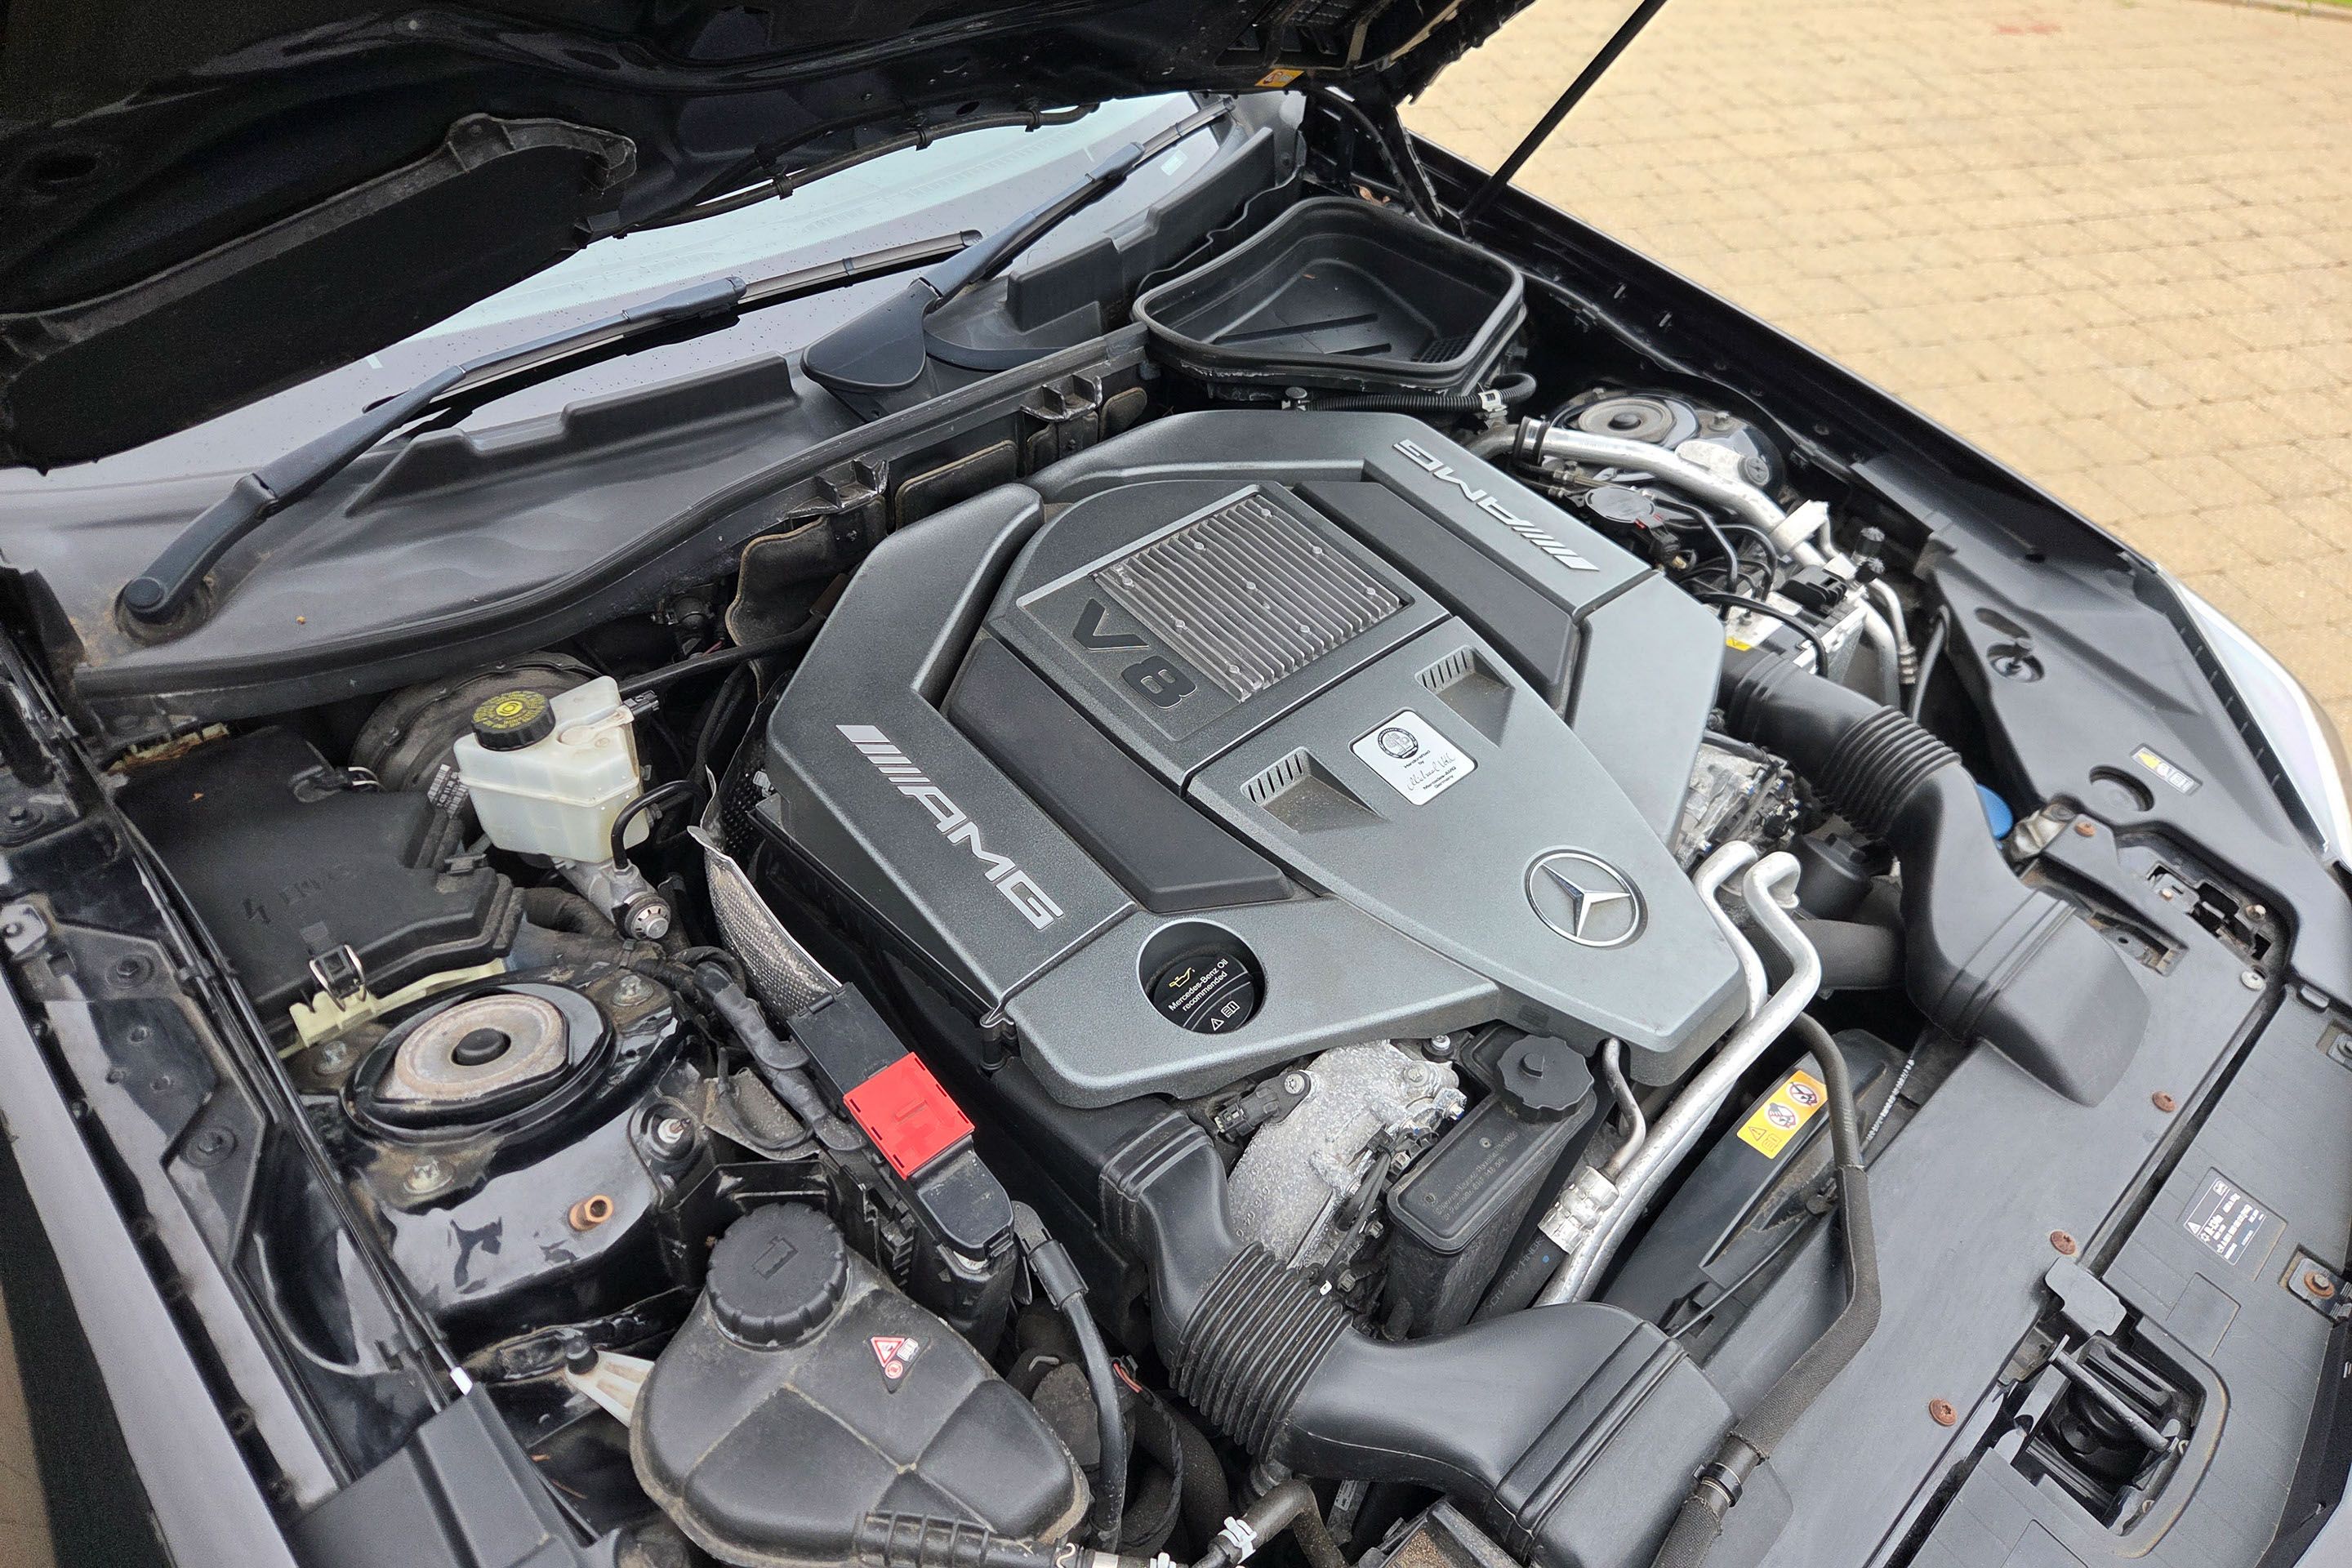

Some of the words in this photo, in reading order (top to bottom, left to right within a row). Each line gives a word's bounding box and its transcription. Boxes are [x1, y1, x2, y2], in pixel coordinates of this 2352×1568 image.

[1392, 439, 1539, 529] AMG
[1072, 598, 1198, 710] V8
[897, 785, 1064, 931] AMG
[1168, 969, 1219, 1012] Mercedes-Benz
[1217, 958, 1229, 970] Oil
[1182, 970, 1228, 1012] recommended
